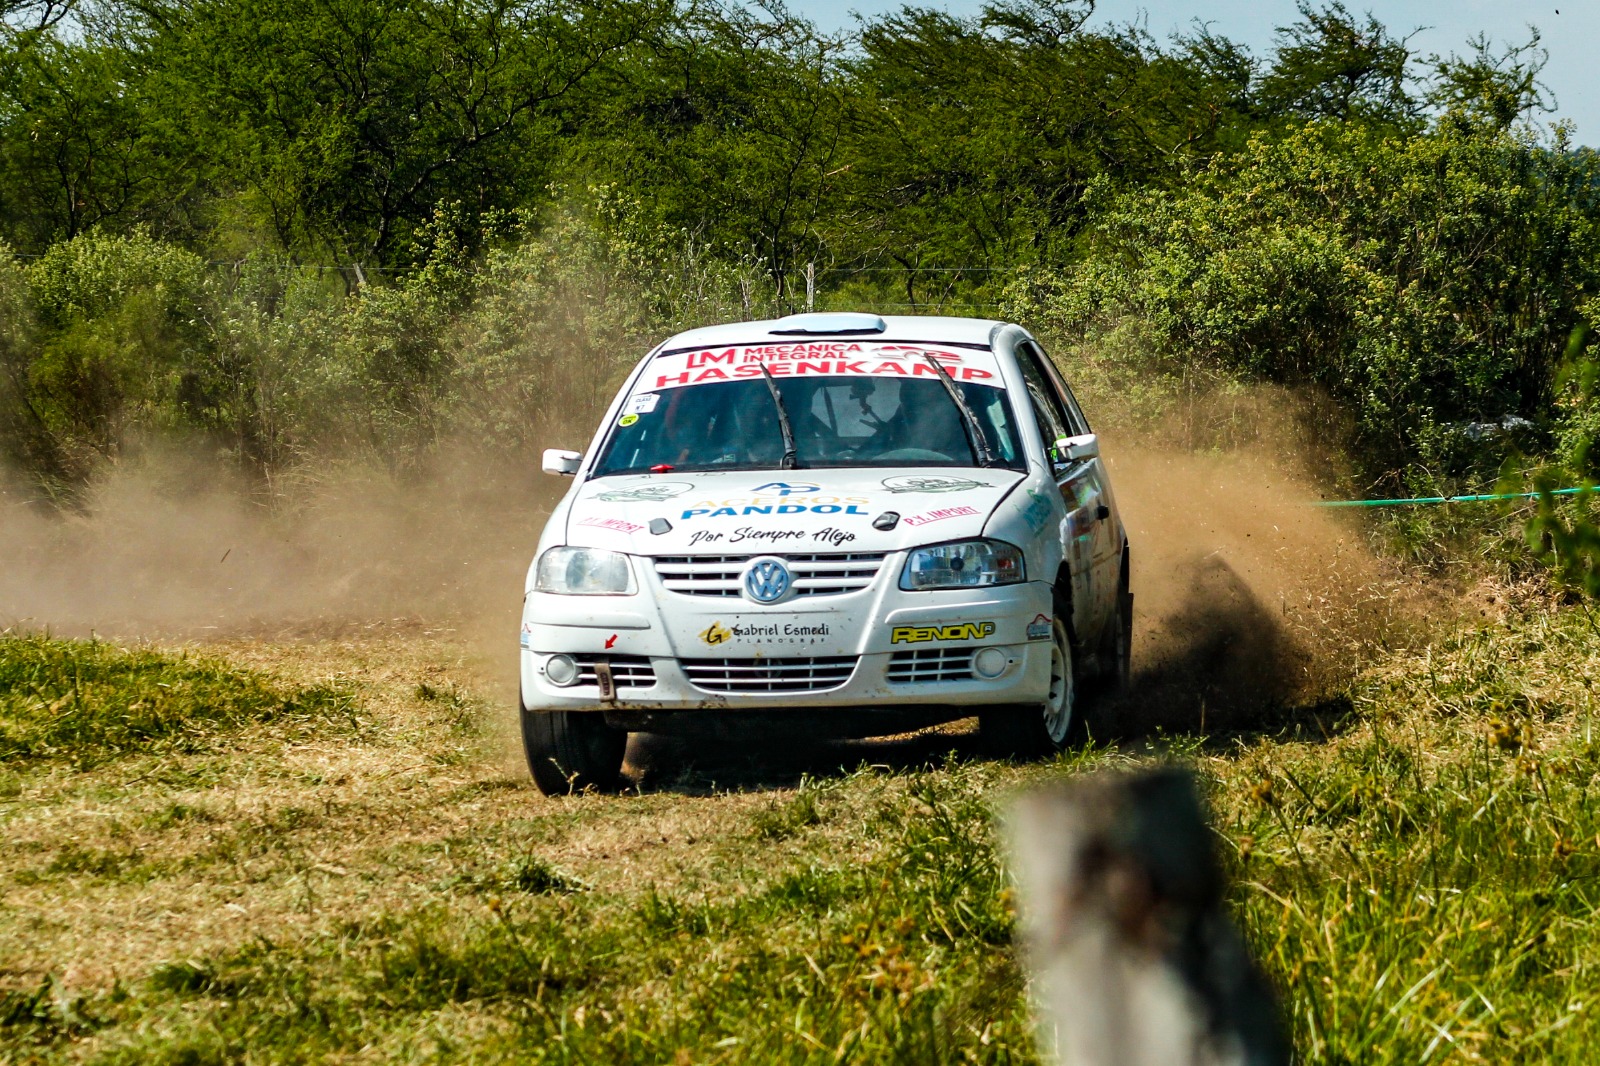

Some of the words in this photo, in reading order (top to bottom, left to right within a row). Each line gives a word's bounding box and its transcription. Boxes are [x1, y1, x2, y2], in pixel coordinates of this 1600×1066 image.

[744, 344, 862, 355] MECANICA
[686, 349, 736, 369] LM
[743, 351, 849, 363] INTEGRAL
[656, 360, 993, 388] HASENKAMP
[691, 496, 870, 508] ACEROS
[680, 504, 870, 520] PANDOL
[926, 506, 981, 519] IMPORT
[688, 530, 724, 546] Por
[729, 526, 806, 543] Siempre
[811, 527, 858, 547] Alejo
[732, 623, 778, 636] Gabriel
[784, 623, 829, 636] Esmedi
